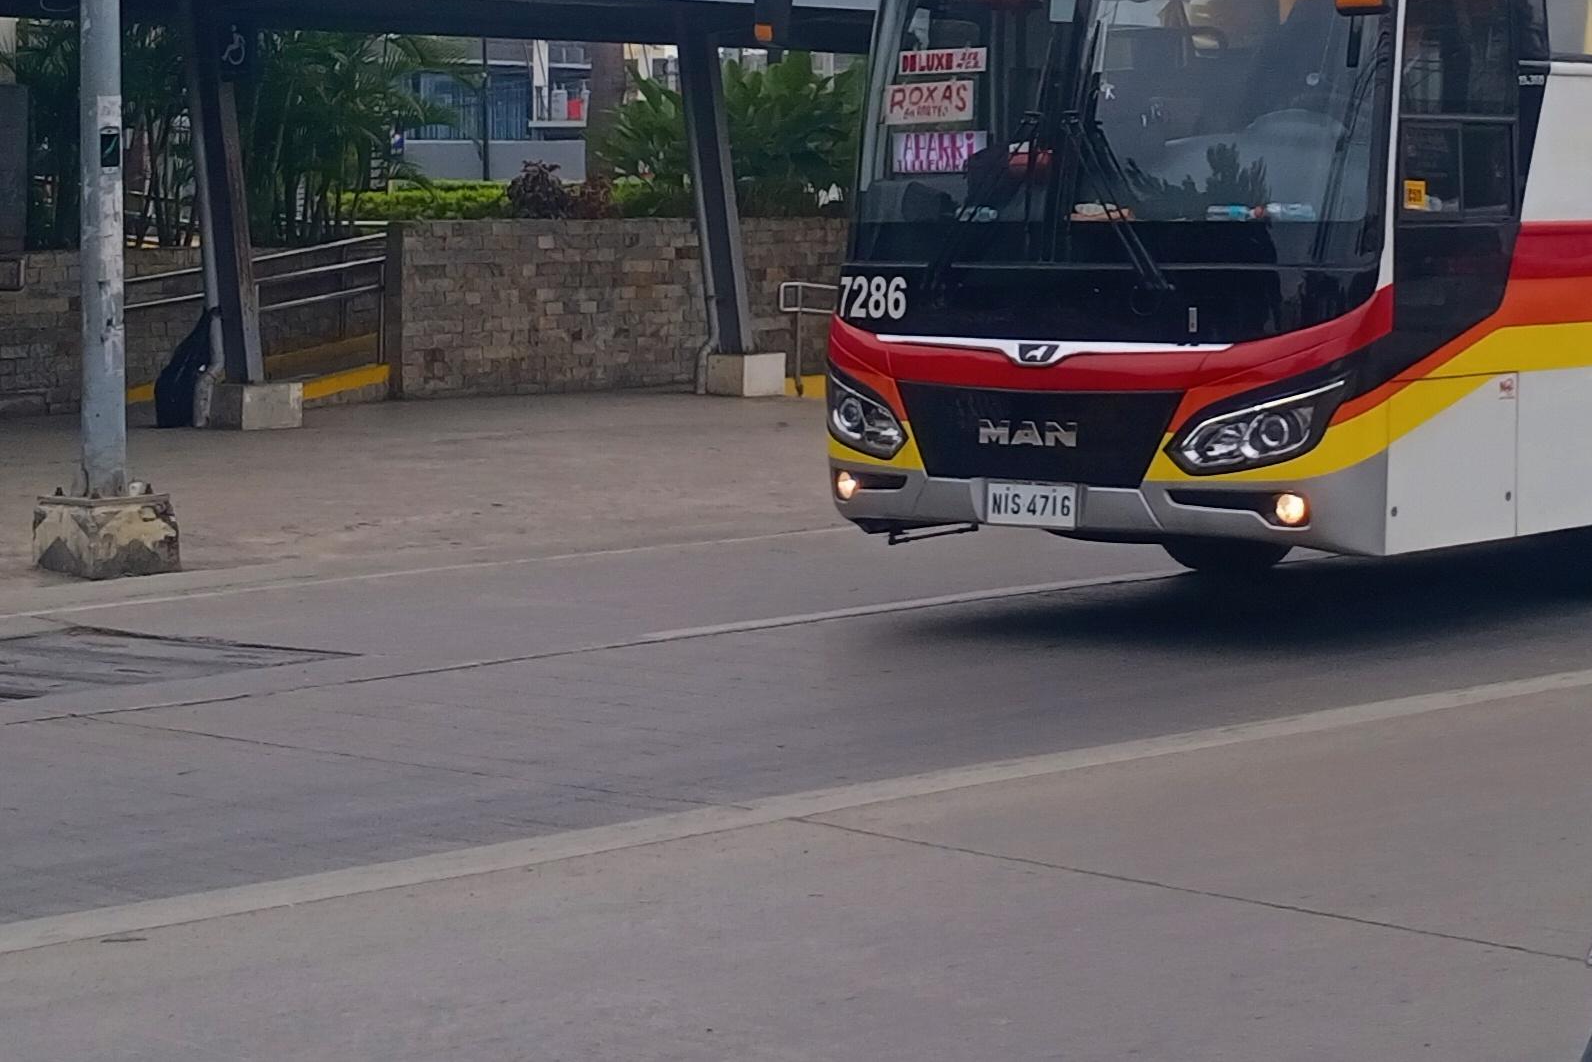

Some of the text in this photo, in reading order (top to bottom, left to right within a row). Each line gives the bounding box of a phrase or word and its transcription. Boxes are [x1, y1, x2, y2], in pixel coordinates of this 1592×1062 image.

[902, 53, 953, 72] DELUXE
[890, 84, 967, 114] ROXAS
[840, 276, 907, 319] 7286
[979, 419, 1078, 447] MAN
[992, 492, 1071, 517] NIS 4716
